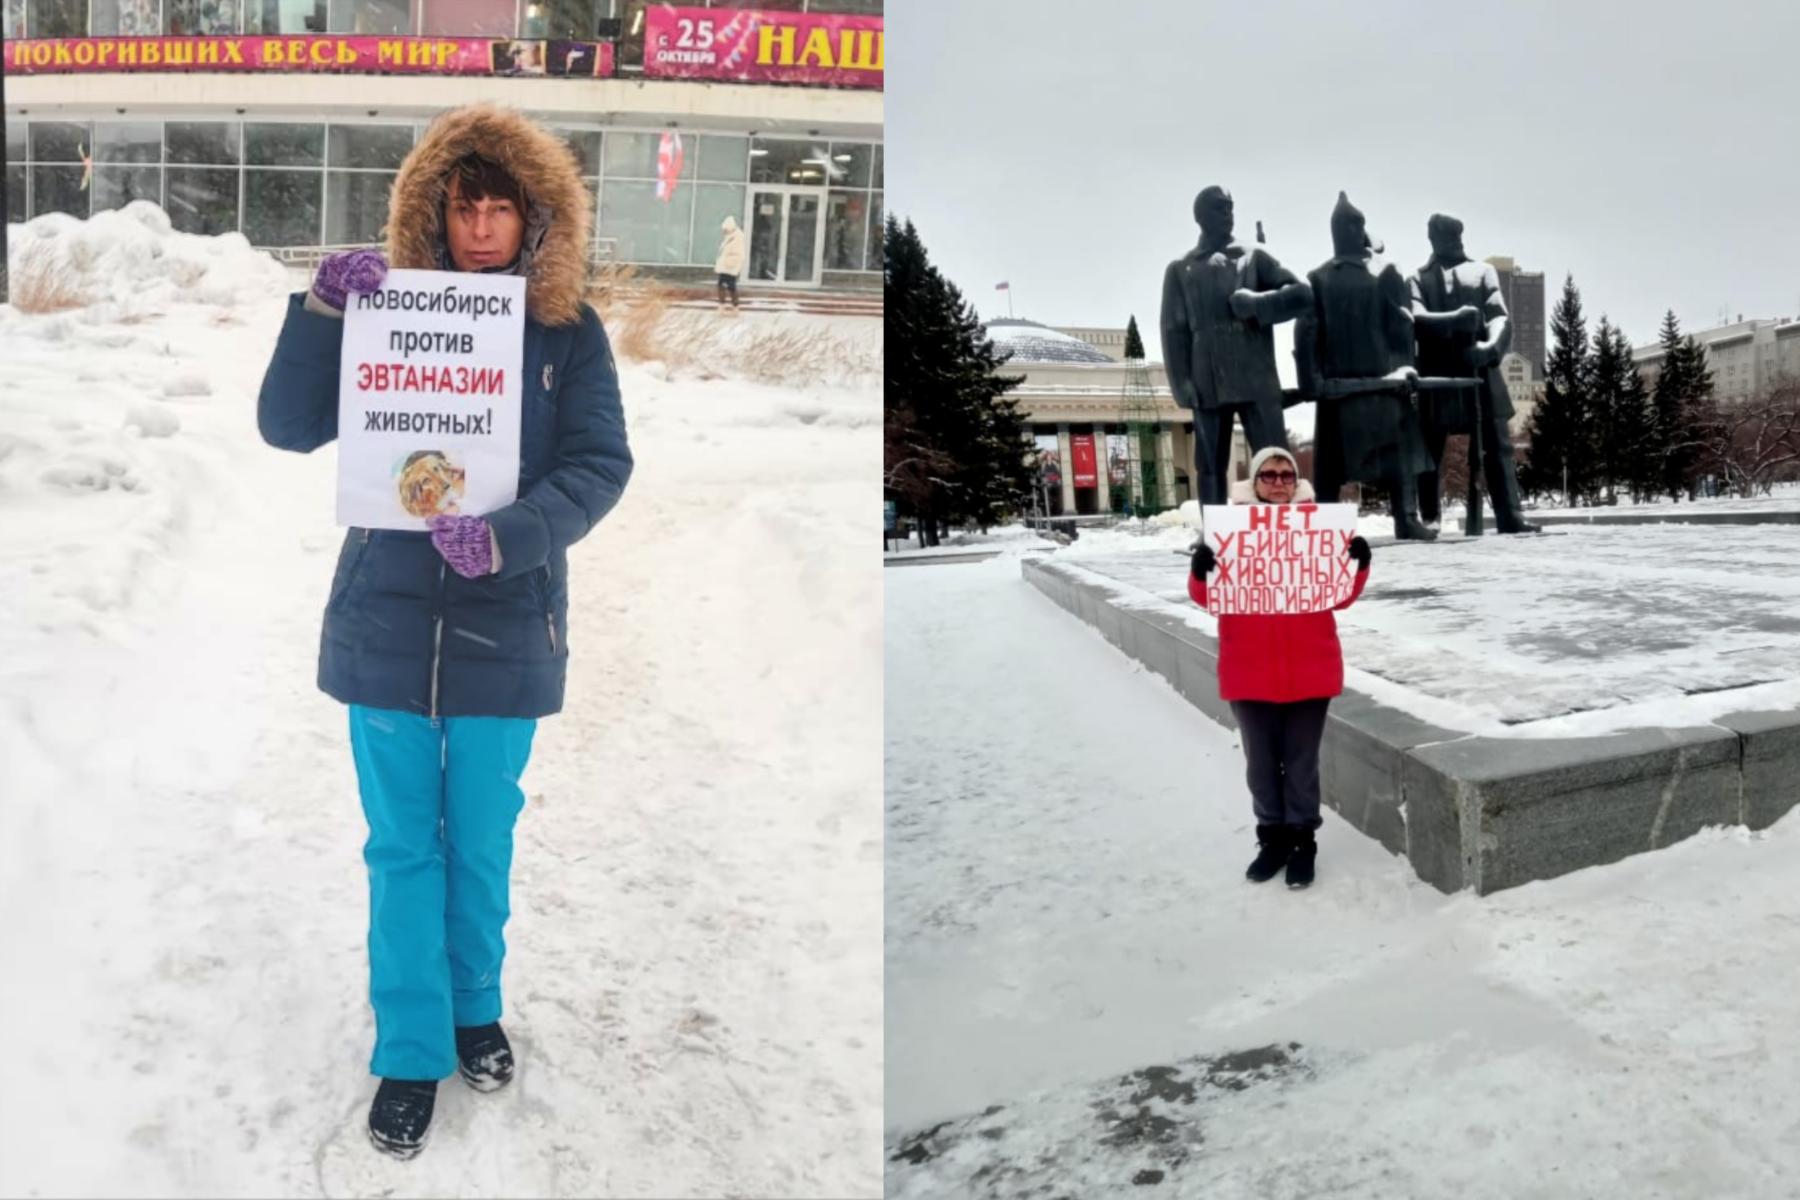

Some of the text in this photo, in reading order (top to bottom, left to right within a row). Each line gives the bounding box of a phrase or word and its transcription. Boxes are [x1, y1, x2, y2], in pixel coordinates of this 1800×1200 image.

[676, 19, 714, 49] 25
[756, 25, 884, 70] НАШ
[14, 39, 458, 66] ПОКОРИВШИХ ВЕСЬ МИР
[390, 330, 473, 358] против
[357, 363, 504, 395] ЭВТАНАЗИИ
[364, 408, 493, 435] животных!
[1250, 505, 1318, 531] НЕТ
[1215, 557, 1352, 586] ЖИВОТНЫХ
